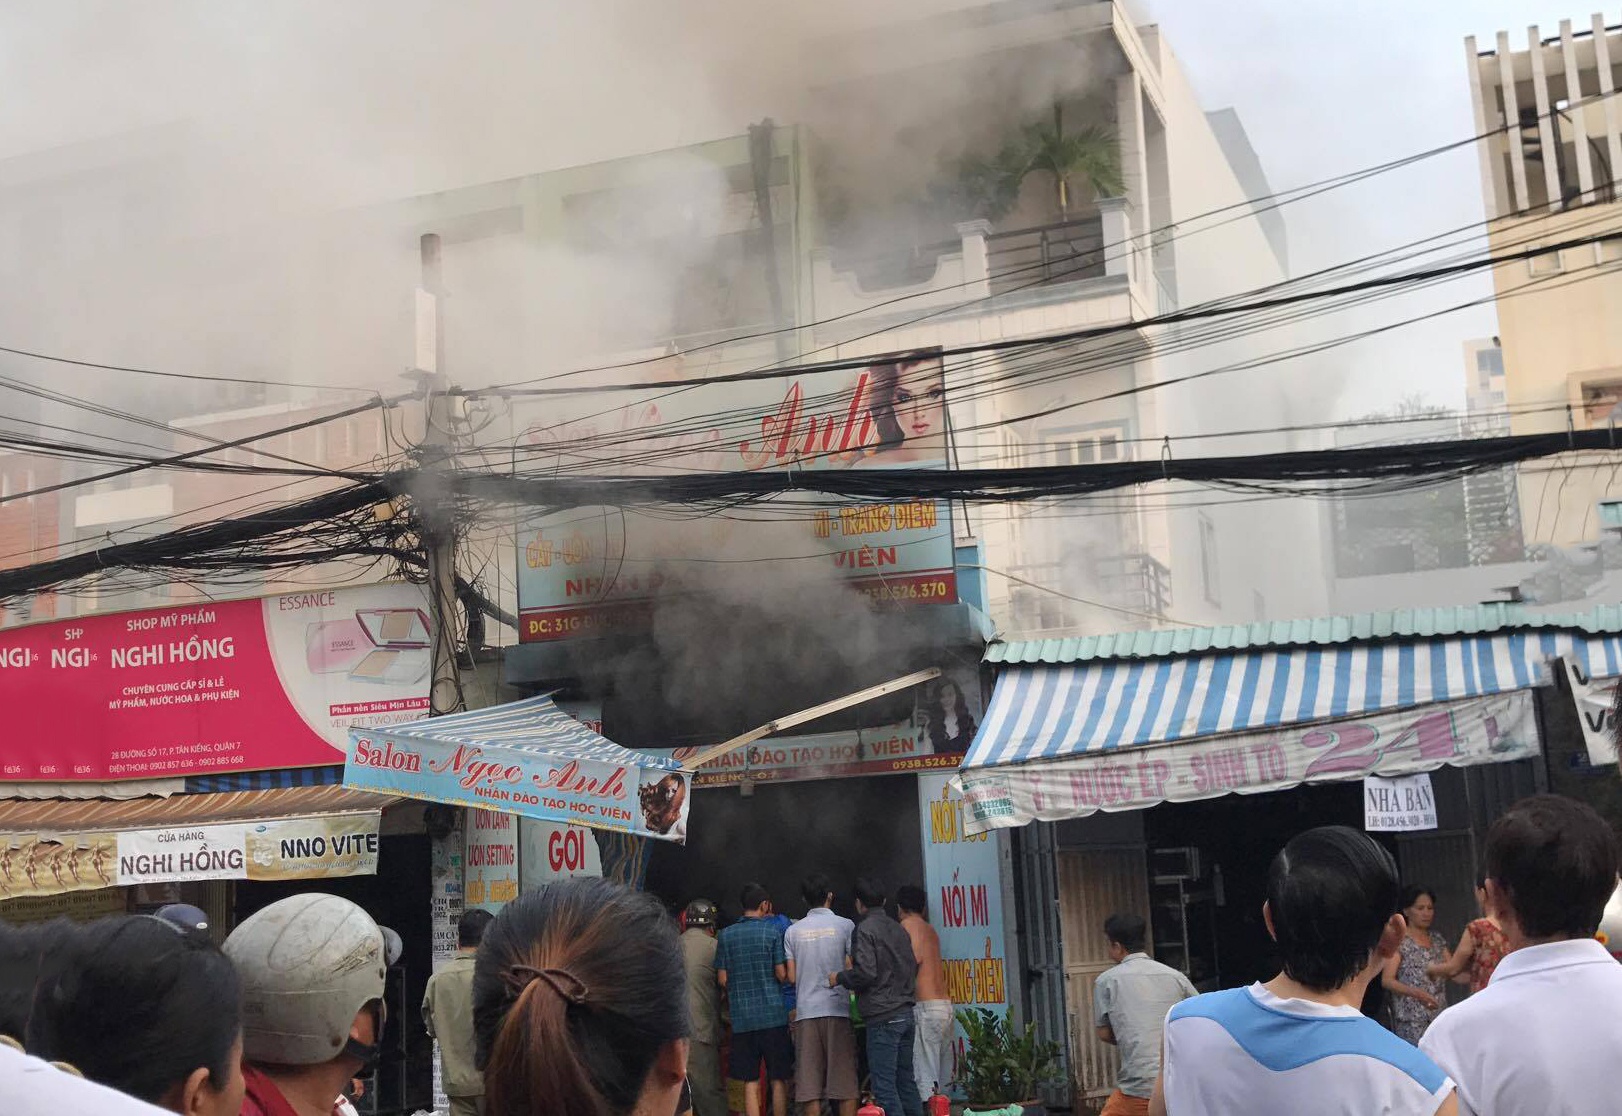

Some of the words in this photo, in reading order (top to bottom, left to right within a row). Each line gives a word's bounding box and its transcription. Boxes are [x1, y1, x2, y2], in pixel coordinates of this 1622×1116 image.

[739, 371, 878, 469] Anh
[839, 504, 893, 537] TRANG
[279, 592, 335, 611] ESSANCE
[127, 617, 158, 631] SHOP
[161, 613, 178, 628] MỸ
[529, 620, 552, 634] ĐC:
[555, 616, 580, 632] 31G
[111, 644, 163, 669] NGHI
[169, 634, 235, 664] HỒNG
[123, 683, 155, 696] CHUYÊN
[156, 682, 179, 693] CUNG
[150, 693, 174, 706] NƯỚC
[175, 694, 193, 704] HOA
[194, 694, 200, 702] &
[201, 692, 219, 703] PHỤ
[406, 699, 422, 709] Lâu
[236, 741, 241, 750] 7
[871, 734, 915, 757] VIÊN
[149, 761, 166, 771] 0902
[167, 760, 180, 769] 857
[199, 757, 215, 767] 0902
[354, 737, 422, 774] Salon
[429, 743, 523, 789] Ngọc
[532, 759, 627, 800] Anh
[1190, 750, 1248, 804] SINH
[513, 791, 539, 805] ĐÀO
[600, 806, 632, 821] VIÊN
[1368, 780, 1401, 812] NHÀ
[1405, 778, 1431, 811] BÁN
[158, 833, 177, 843] CỬA
[178, 831, 205, 841] HÀNG
[281, 836, 326, 859] NNO
[332, 833, 378, 856] VITE
[120, 853, 172, 876] NGHI
[180, 842, 243, 872] HỒNG
[486, 844, 514, 866] SETTING
[941, 867, 966, 927] NỐI
[970, 884, 988, 926] MI
[942, 959, 973, 1005] RANG
[973, 936, 1006, 1005] ĐIỂM
